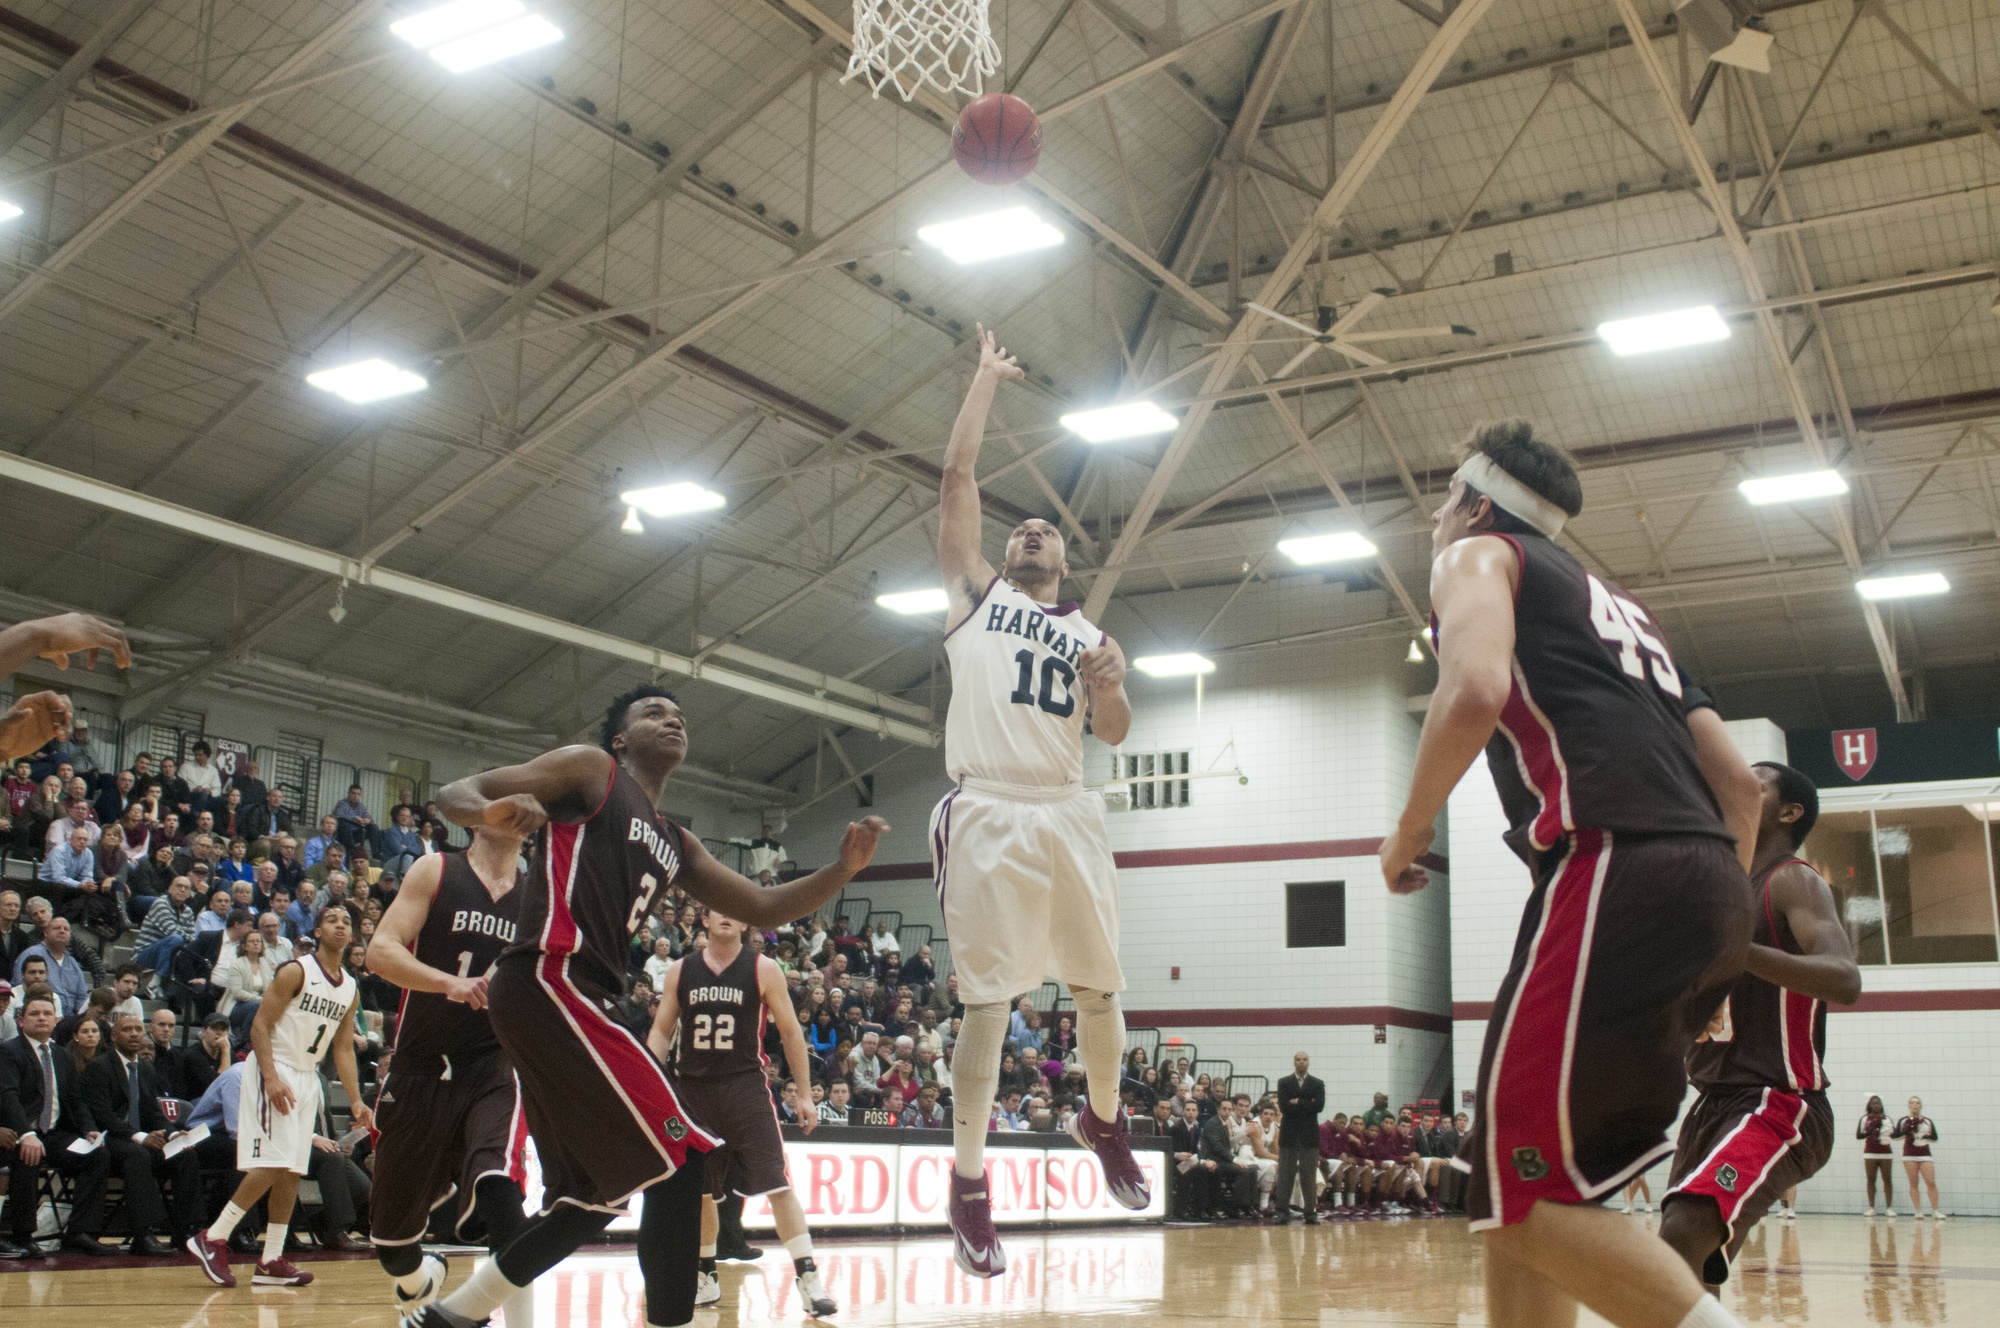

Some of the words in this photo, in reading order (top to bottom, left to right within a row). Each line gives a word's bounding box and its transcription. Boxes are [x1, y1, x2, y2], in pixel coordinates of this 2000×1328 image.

[986, 603, 1087, 675] HARVAR
[1587, 573, 1683, 699] 45
[1011, 648, 1076, 718] 10
[218, 739, 248, 754] SECTION
[1843, 734, 1868, 766] H
[225, 752, 236, 775] 3
[628, 817, 679, 884] BROWN
[627, 873, 657, 933] 2
[452, 910, 517, 943] BROW
[299, 992, 346, 1022] HARVAR
[689, 986, 743, 1005] BROWN
[307, 1024, 327, 1054] 1
[693, 1014, 735, 1049] 22
[165, 1102, 177, 1116] H
[252, 1138, 261, 1158] H
[908, 1154, 1111, 1214] CIMSO
